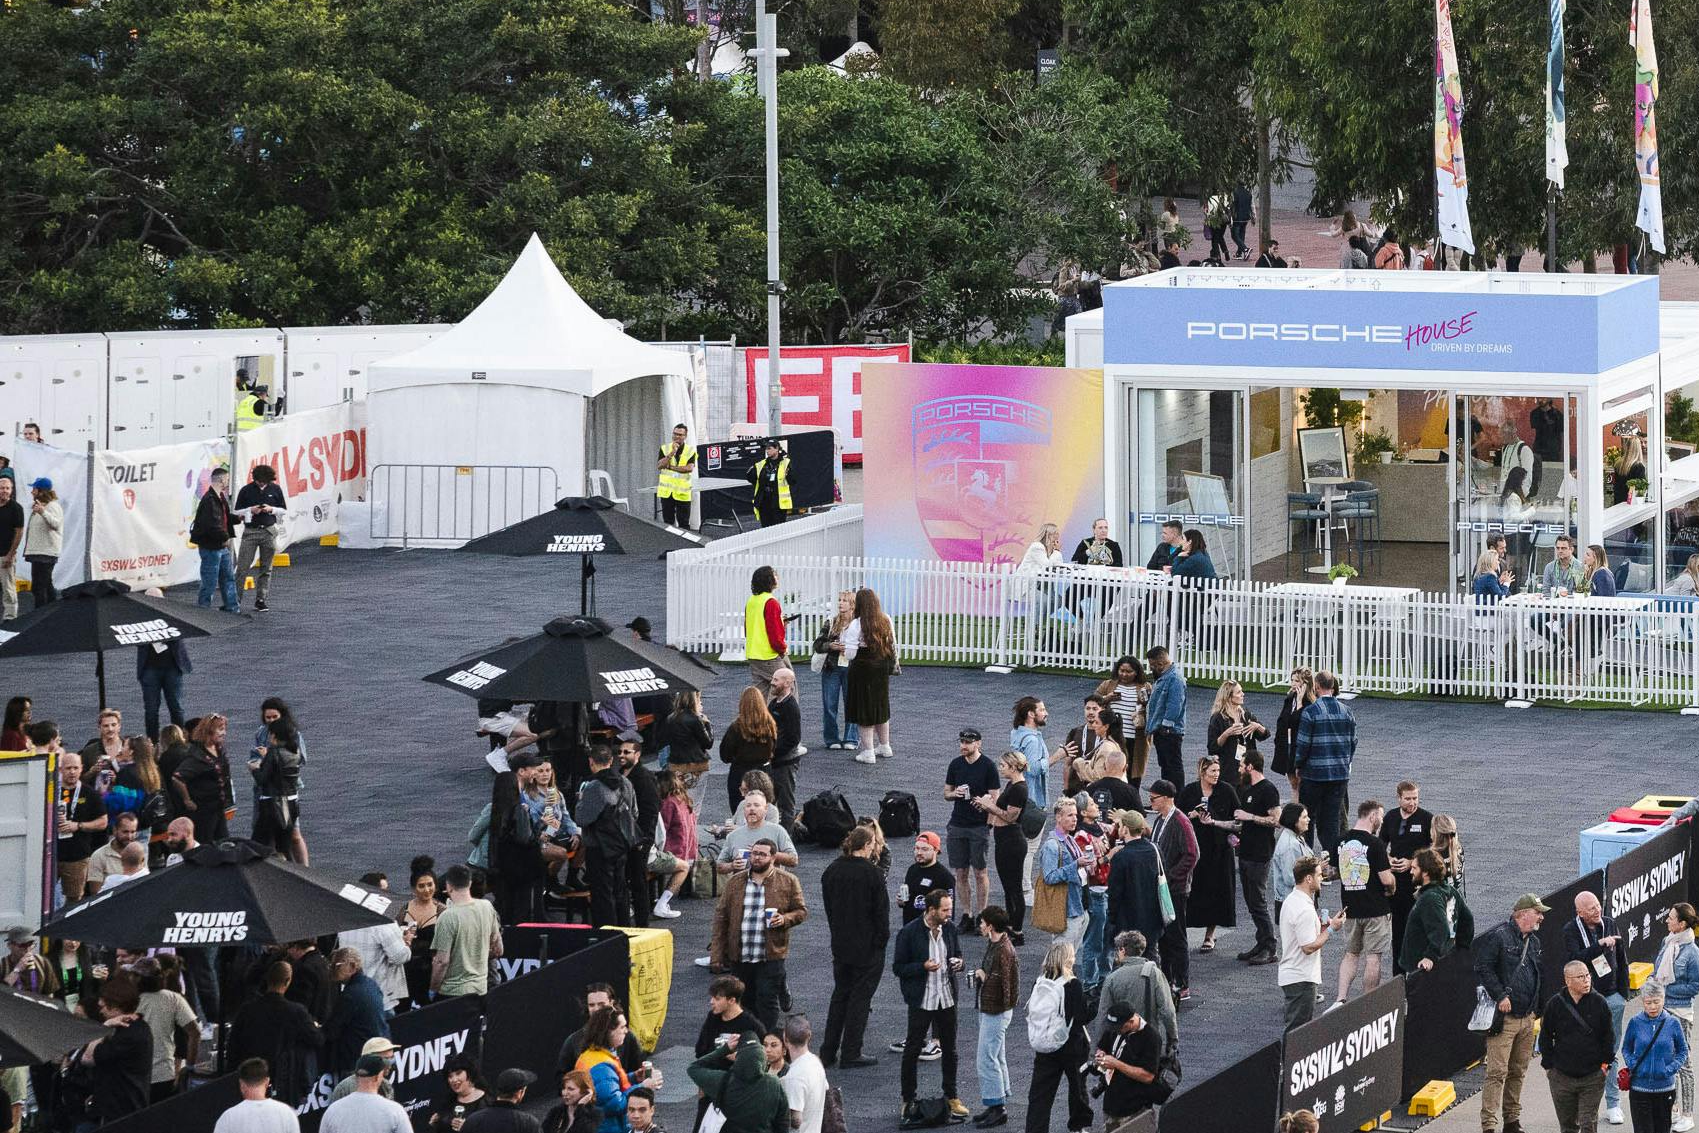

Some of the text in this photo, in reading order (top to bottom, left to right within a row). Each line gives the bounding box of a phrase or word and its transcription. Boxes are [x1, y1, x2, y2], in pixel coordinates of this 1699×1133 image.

[1186, 310, 1478, 352] PORSCHE HOUSE
[1430, 342, 1513, 354] DRIVEN BY DREAMS
[918, 401, 1044, 423] PORSCHE
[105, 462, 157, 485] TOILET
[1138, 513, 1245, 525] PORSCHE
[1456, 521, 1565, 534] PORSCHE
[546, 542, 606, 553] HENRYS
[553, 534, 604, 544] YOUNG
[101, 554, 173, 573] SXSW SYDNEY
[110, 618, 169, 636] YOUNG
[114, 626, 182, 646] HENRYS
[599, 667, 657, 684] YOUNG
[604, 677, 670, 696] HENRYS
[1611, 850, 1686, 919] SXSW SYDNEY
[173, 910, 247, 928] YOUNG
[162, 925, 249, 944] HENRYS
[390, 1028, 470, 1085] YDNEY
[1290, 1008, 1399, 1096] SXSW SYDNEY
